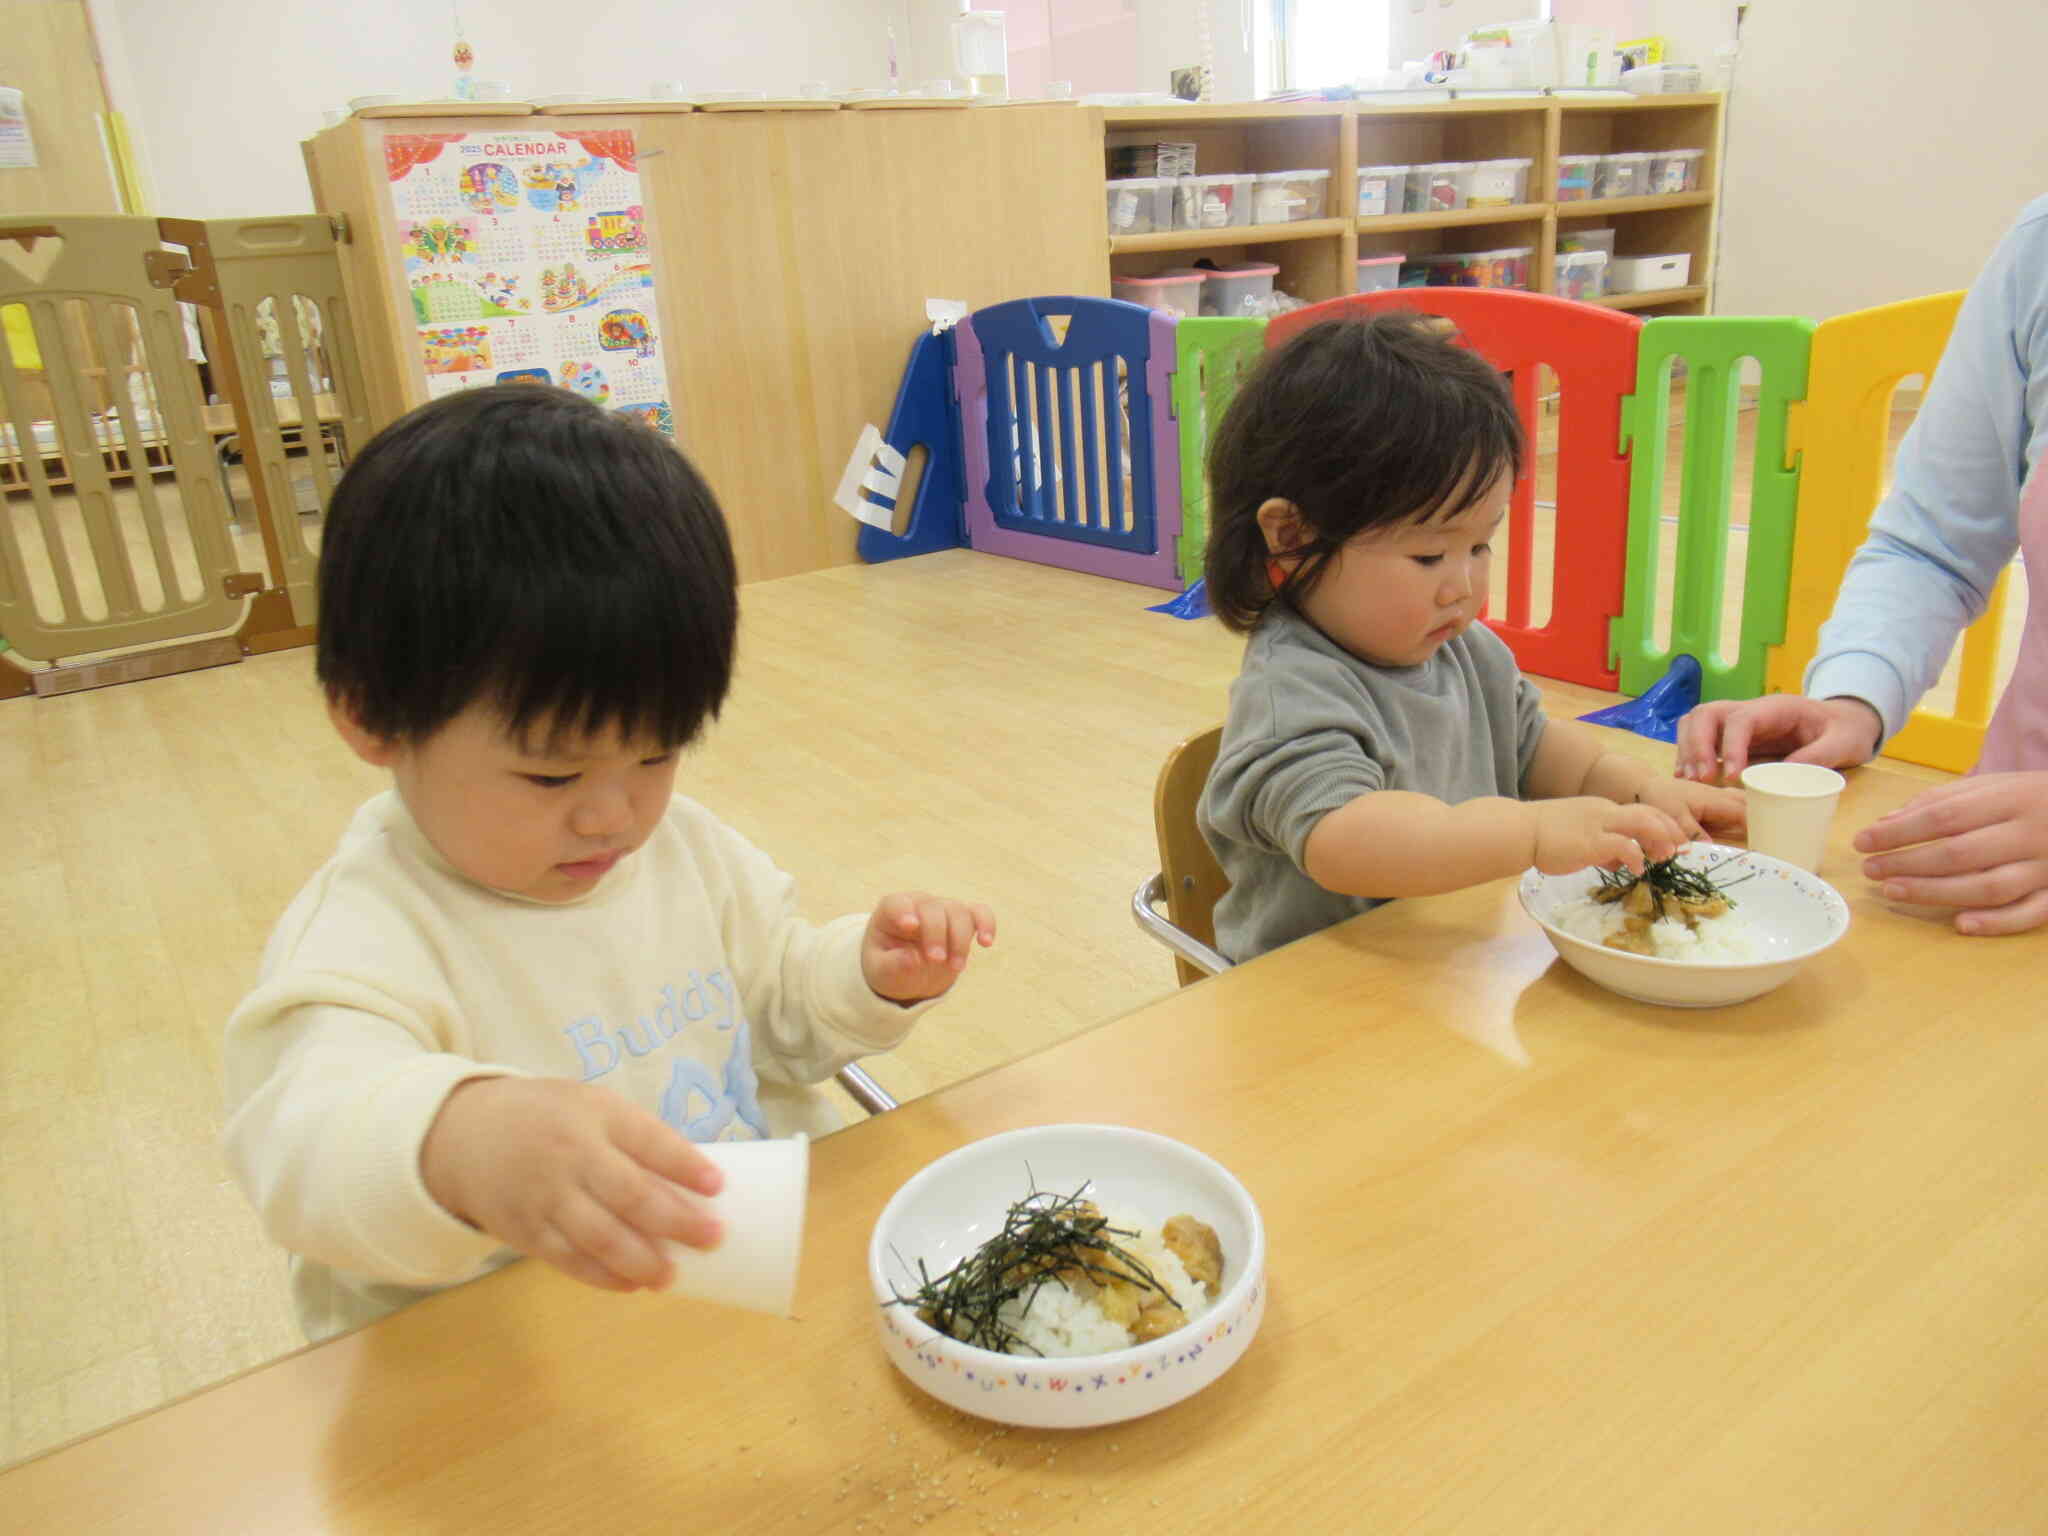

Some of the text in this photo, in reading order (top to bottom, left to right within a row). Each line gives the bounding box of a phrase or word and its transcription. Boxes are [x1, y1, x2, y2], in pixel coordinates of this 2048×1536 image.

[484, 142, 567, 156] CALENDAR
[563, 969, 736, 1082] Buddy
[1049, 1377, 1068, 1392] W
